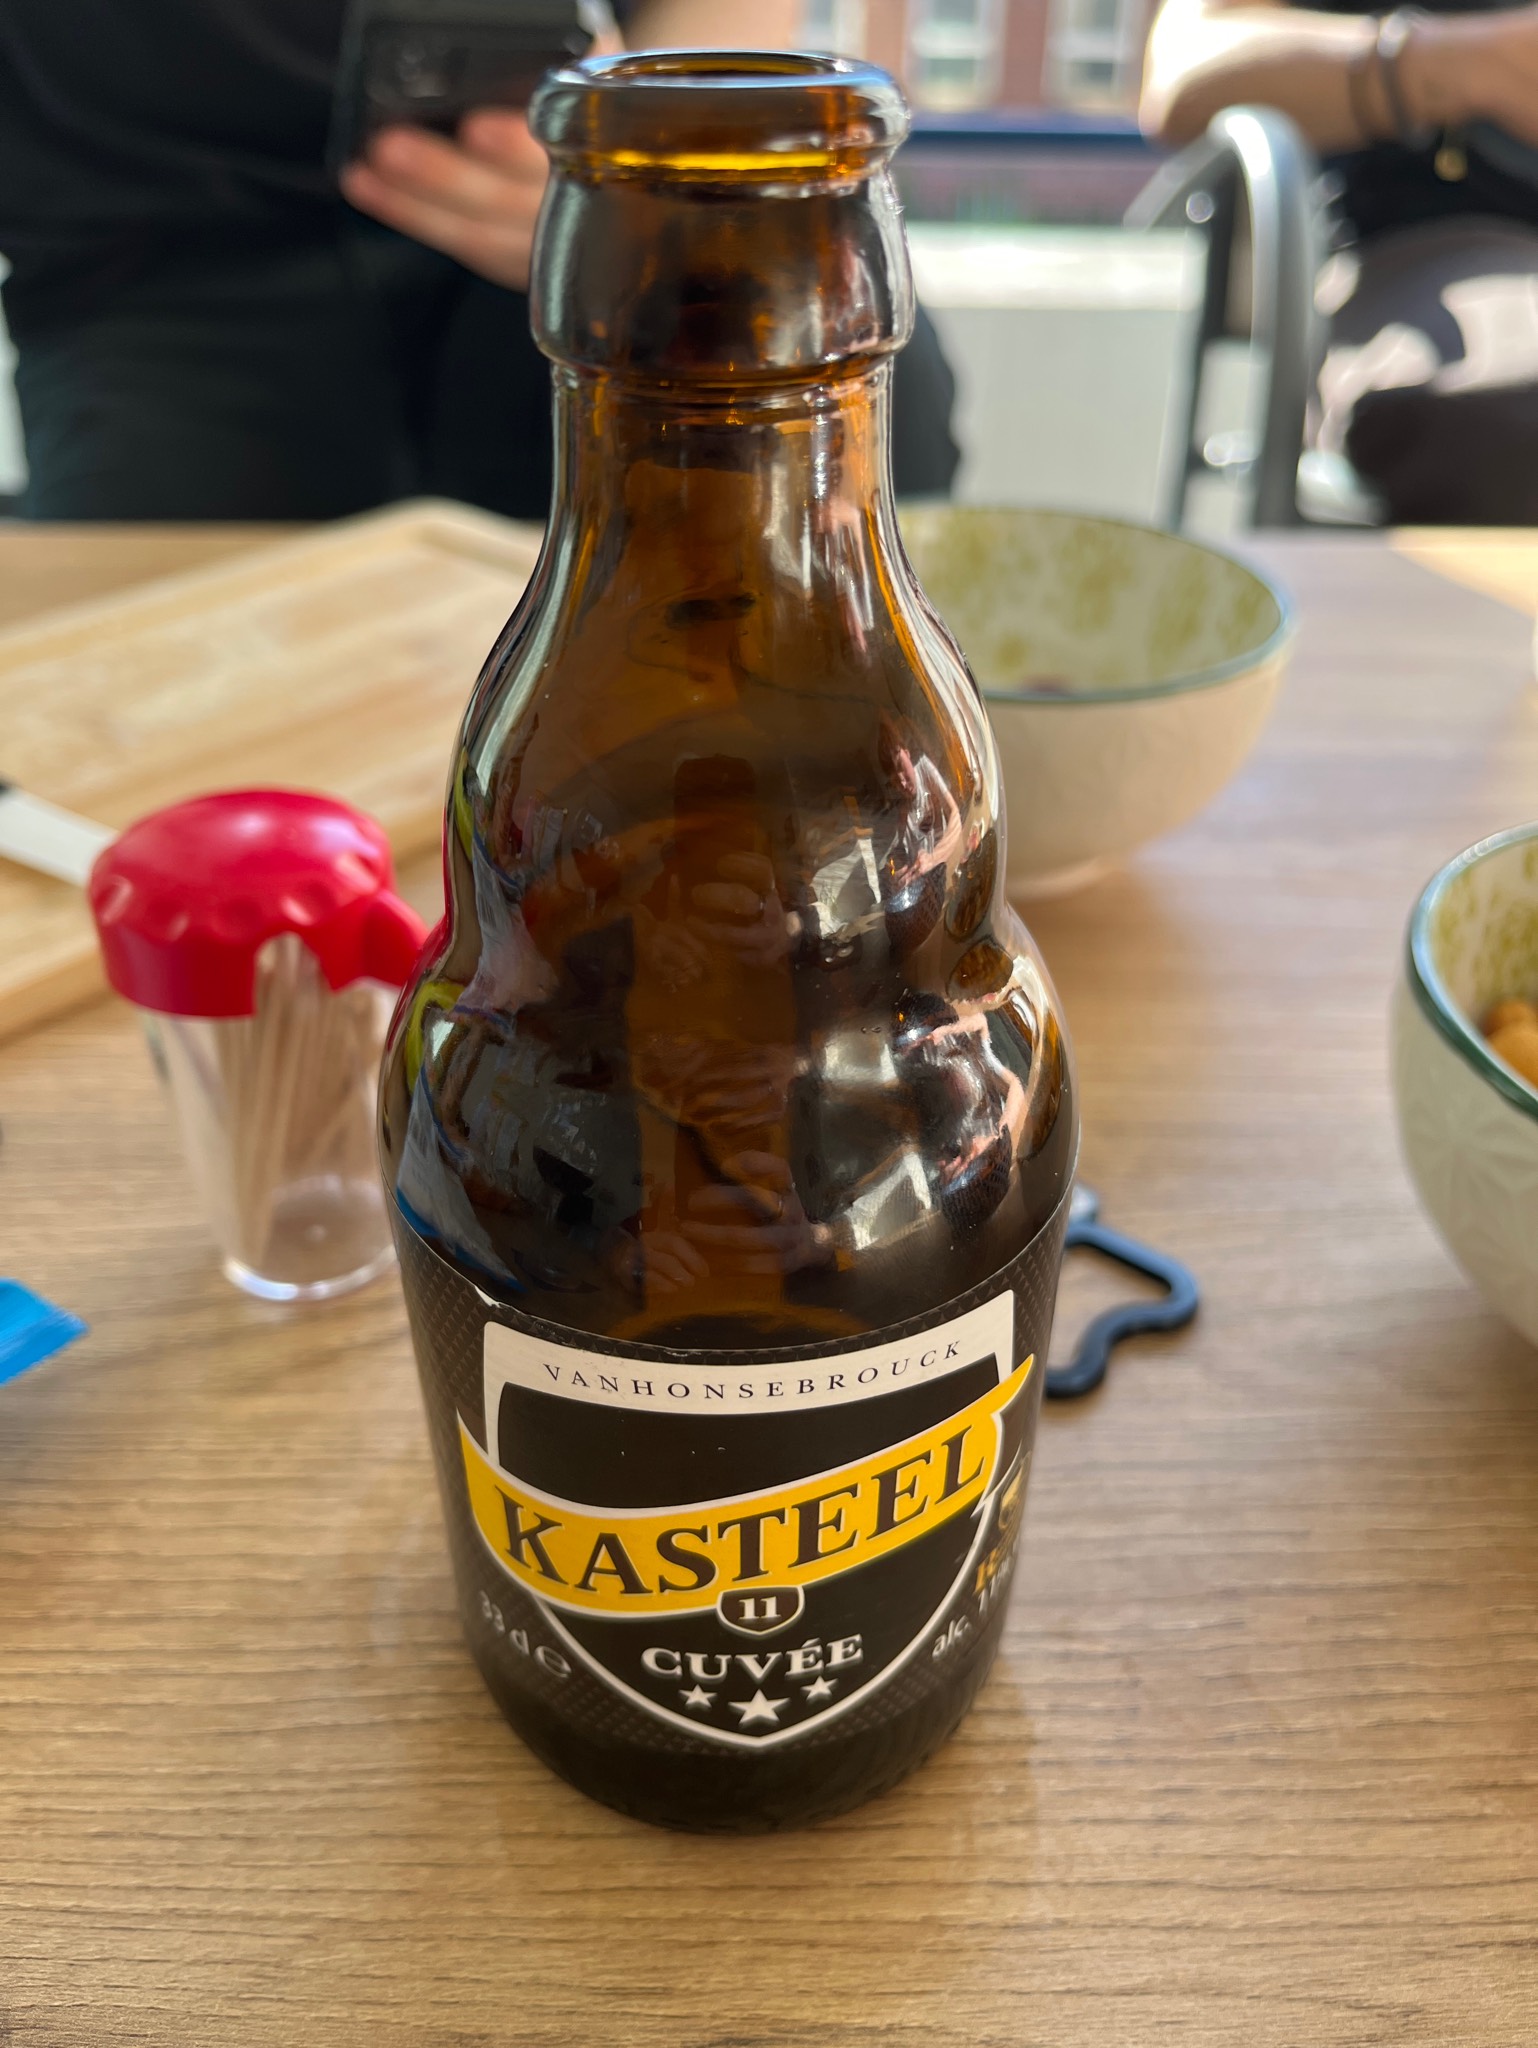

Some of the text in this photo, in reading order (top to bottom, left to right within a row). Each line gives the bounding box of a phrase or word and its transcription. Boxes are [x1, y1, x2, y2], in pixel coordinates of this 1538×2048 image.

[544, 1339, 961, 1399] VANHONSEBROUCK
[495, 1426, 988, 1594] KASTEEL
[641, 1633, 863, 1680] CUVÉE
